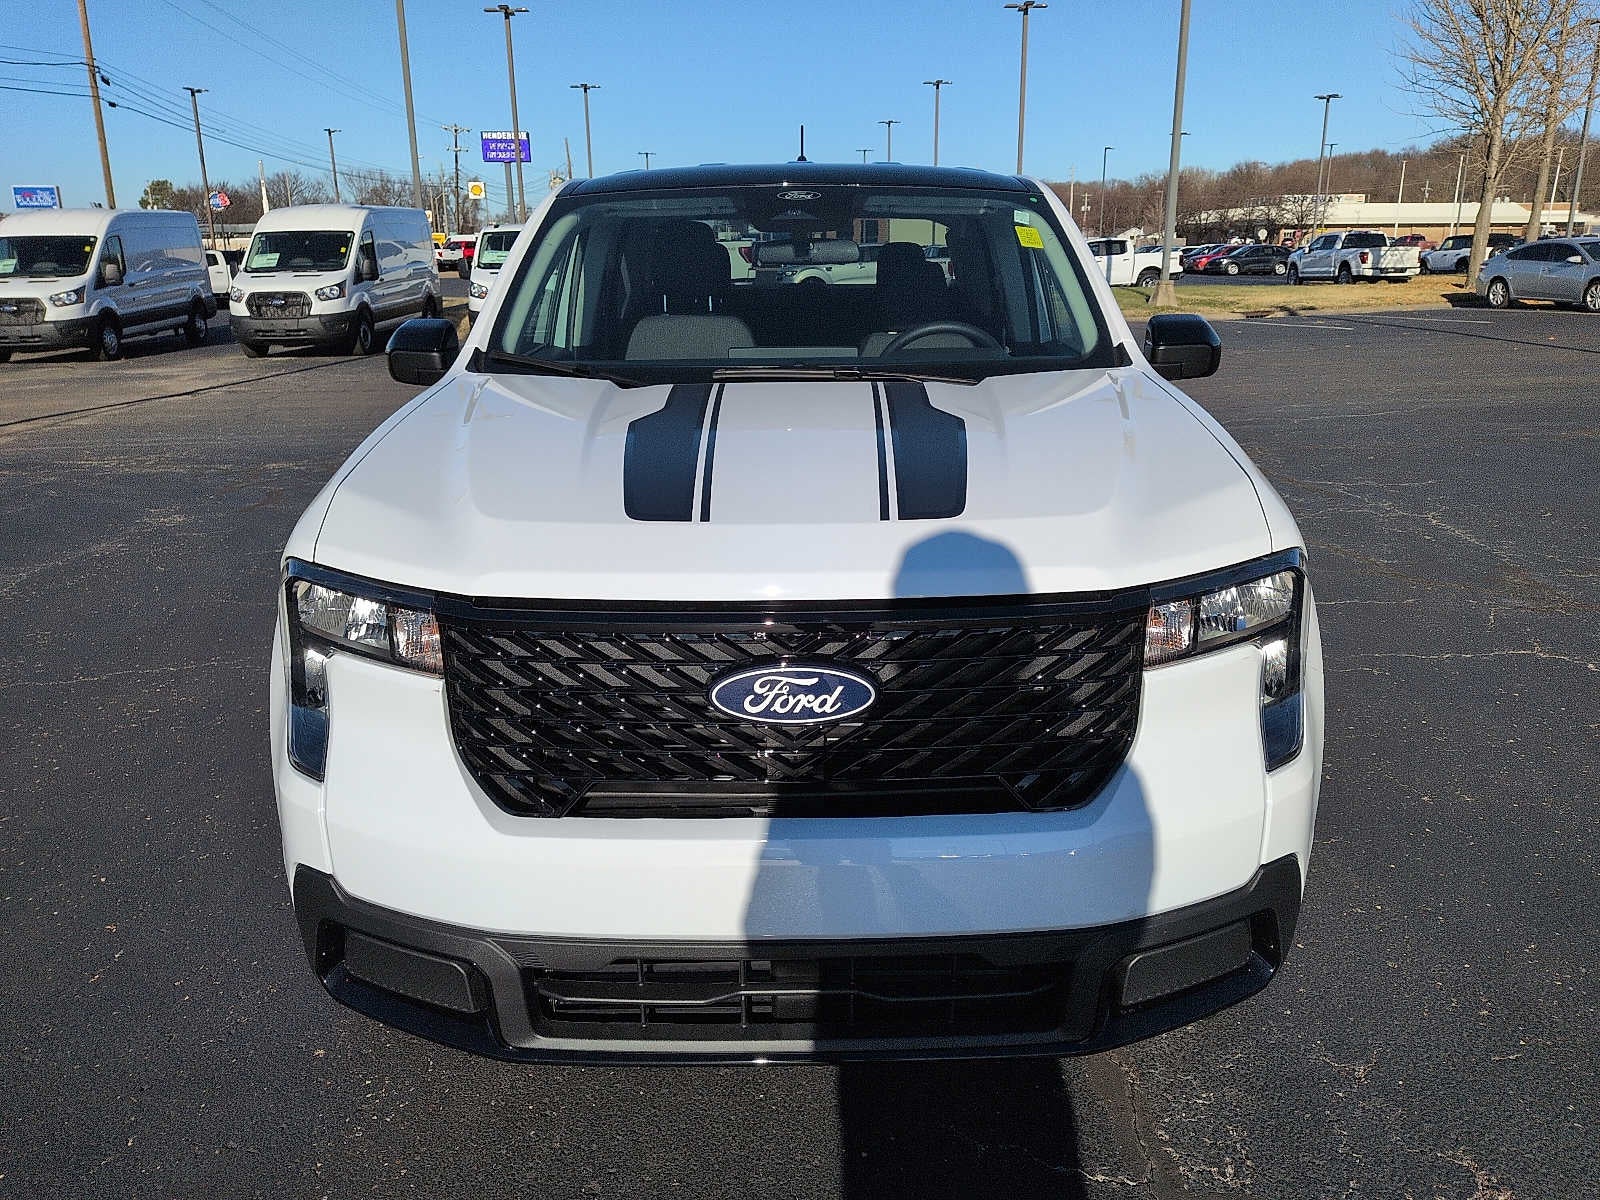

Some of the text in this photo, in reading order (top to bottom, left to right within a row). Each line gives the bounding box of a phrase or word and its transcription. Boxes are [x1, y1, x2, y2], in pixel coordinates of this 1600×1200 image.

[482, 131, 528, 140] HENDERON
[784, 191, 814, 200] Ford
[743, 675, 845, 714] Ford
